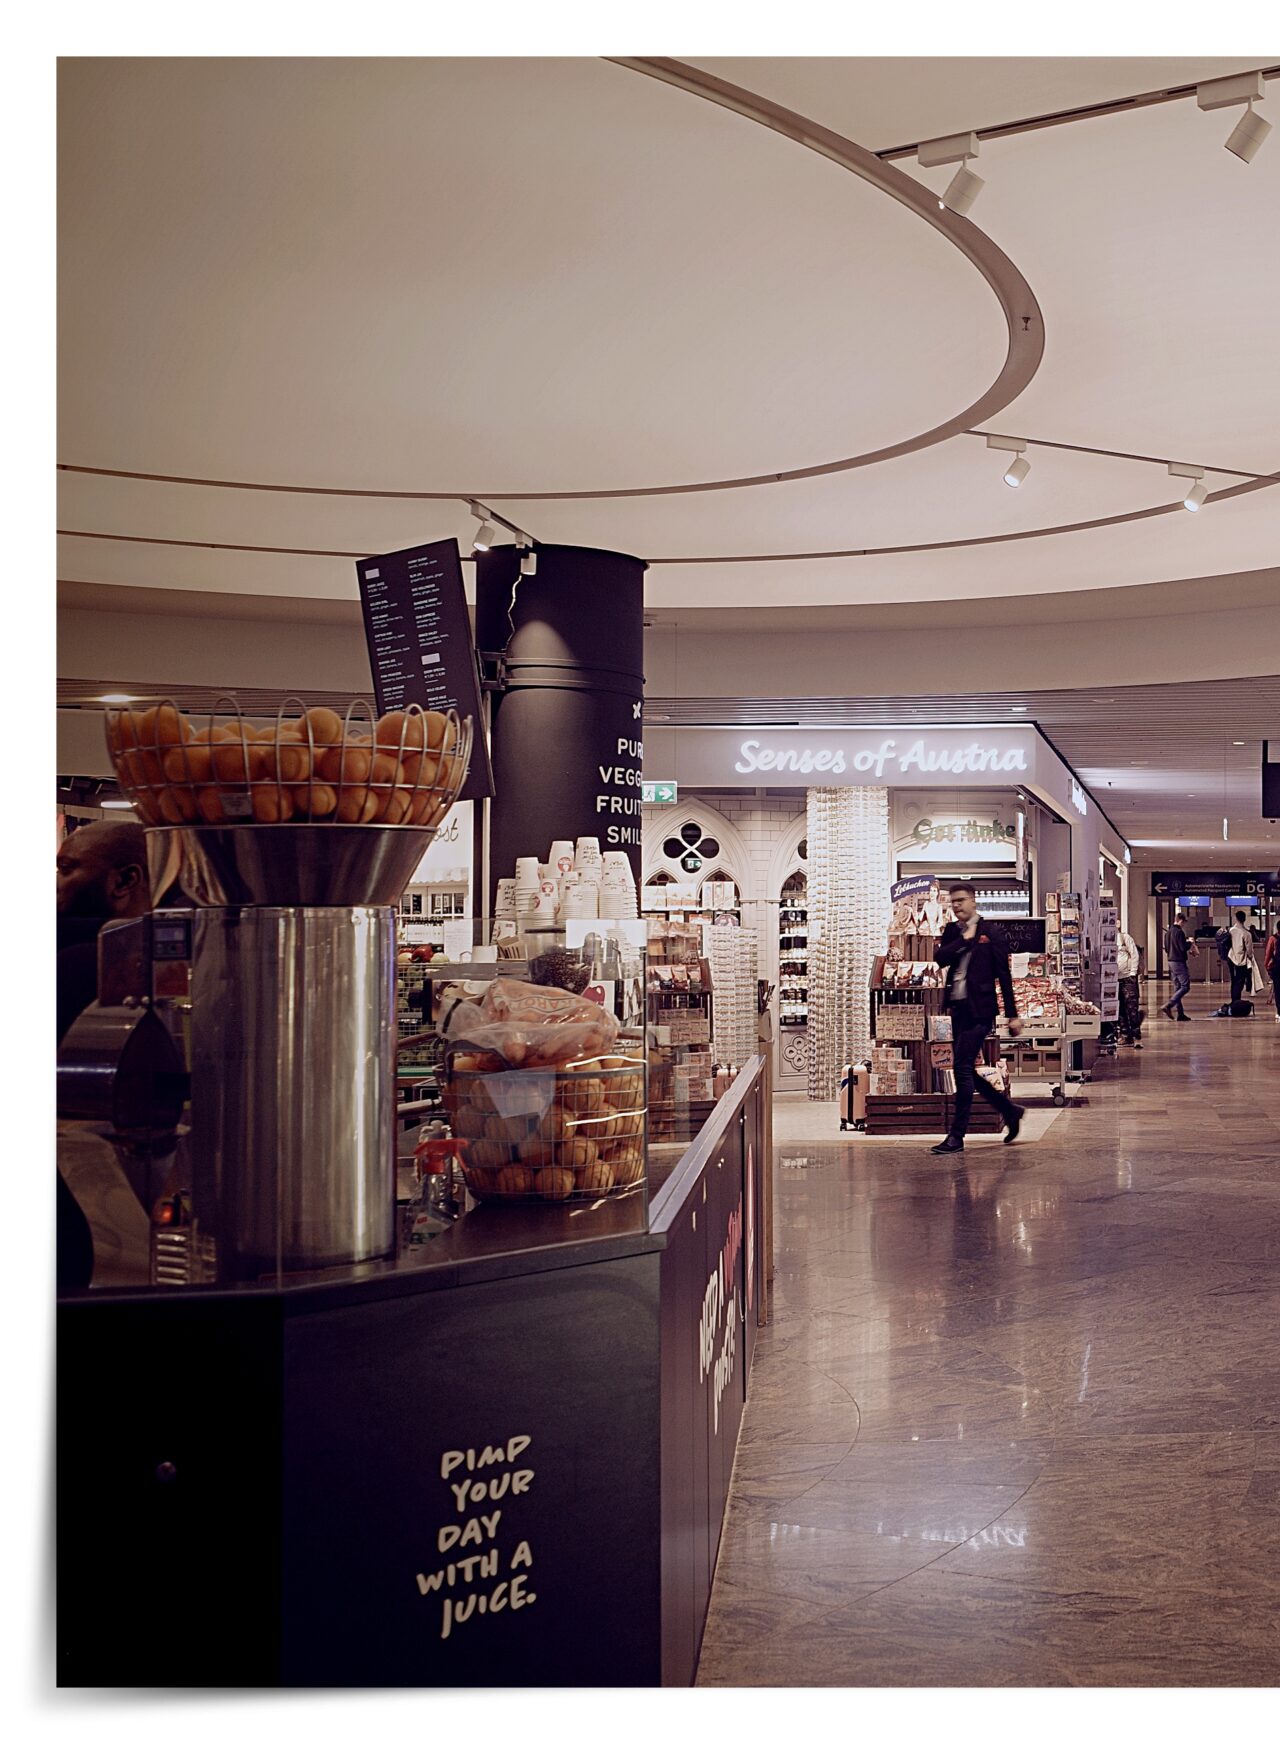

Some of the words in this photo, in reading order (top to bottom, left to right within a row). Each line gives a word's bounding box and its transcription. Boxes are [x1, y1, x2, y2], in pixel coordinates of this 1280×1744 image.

[734, 740, 847, 774] Senses
[852, 739, 896, 778] of
[440, 1435, 532, 1480] PIMP
[451, 1469, 535, 1512] YOUR
[438, 1510, 502, 1553] DAY
[416, 1548, 499, 1596] WITH
[510, 1540, 533, 1570] A
[440, 1574, 537, 1640] JUICE.
